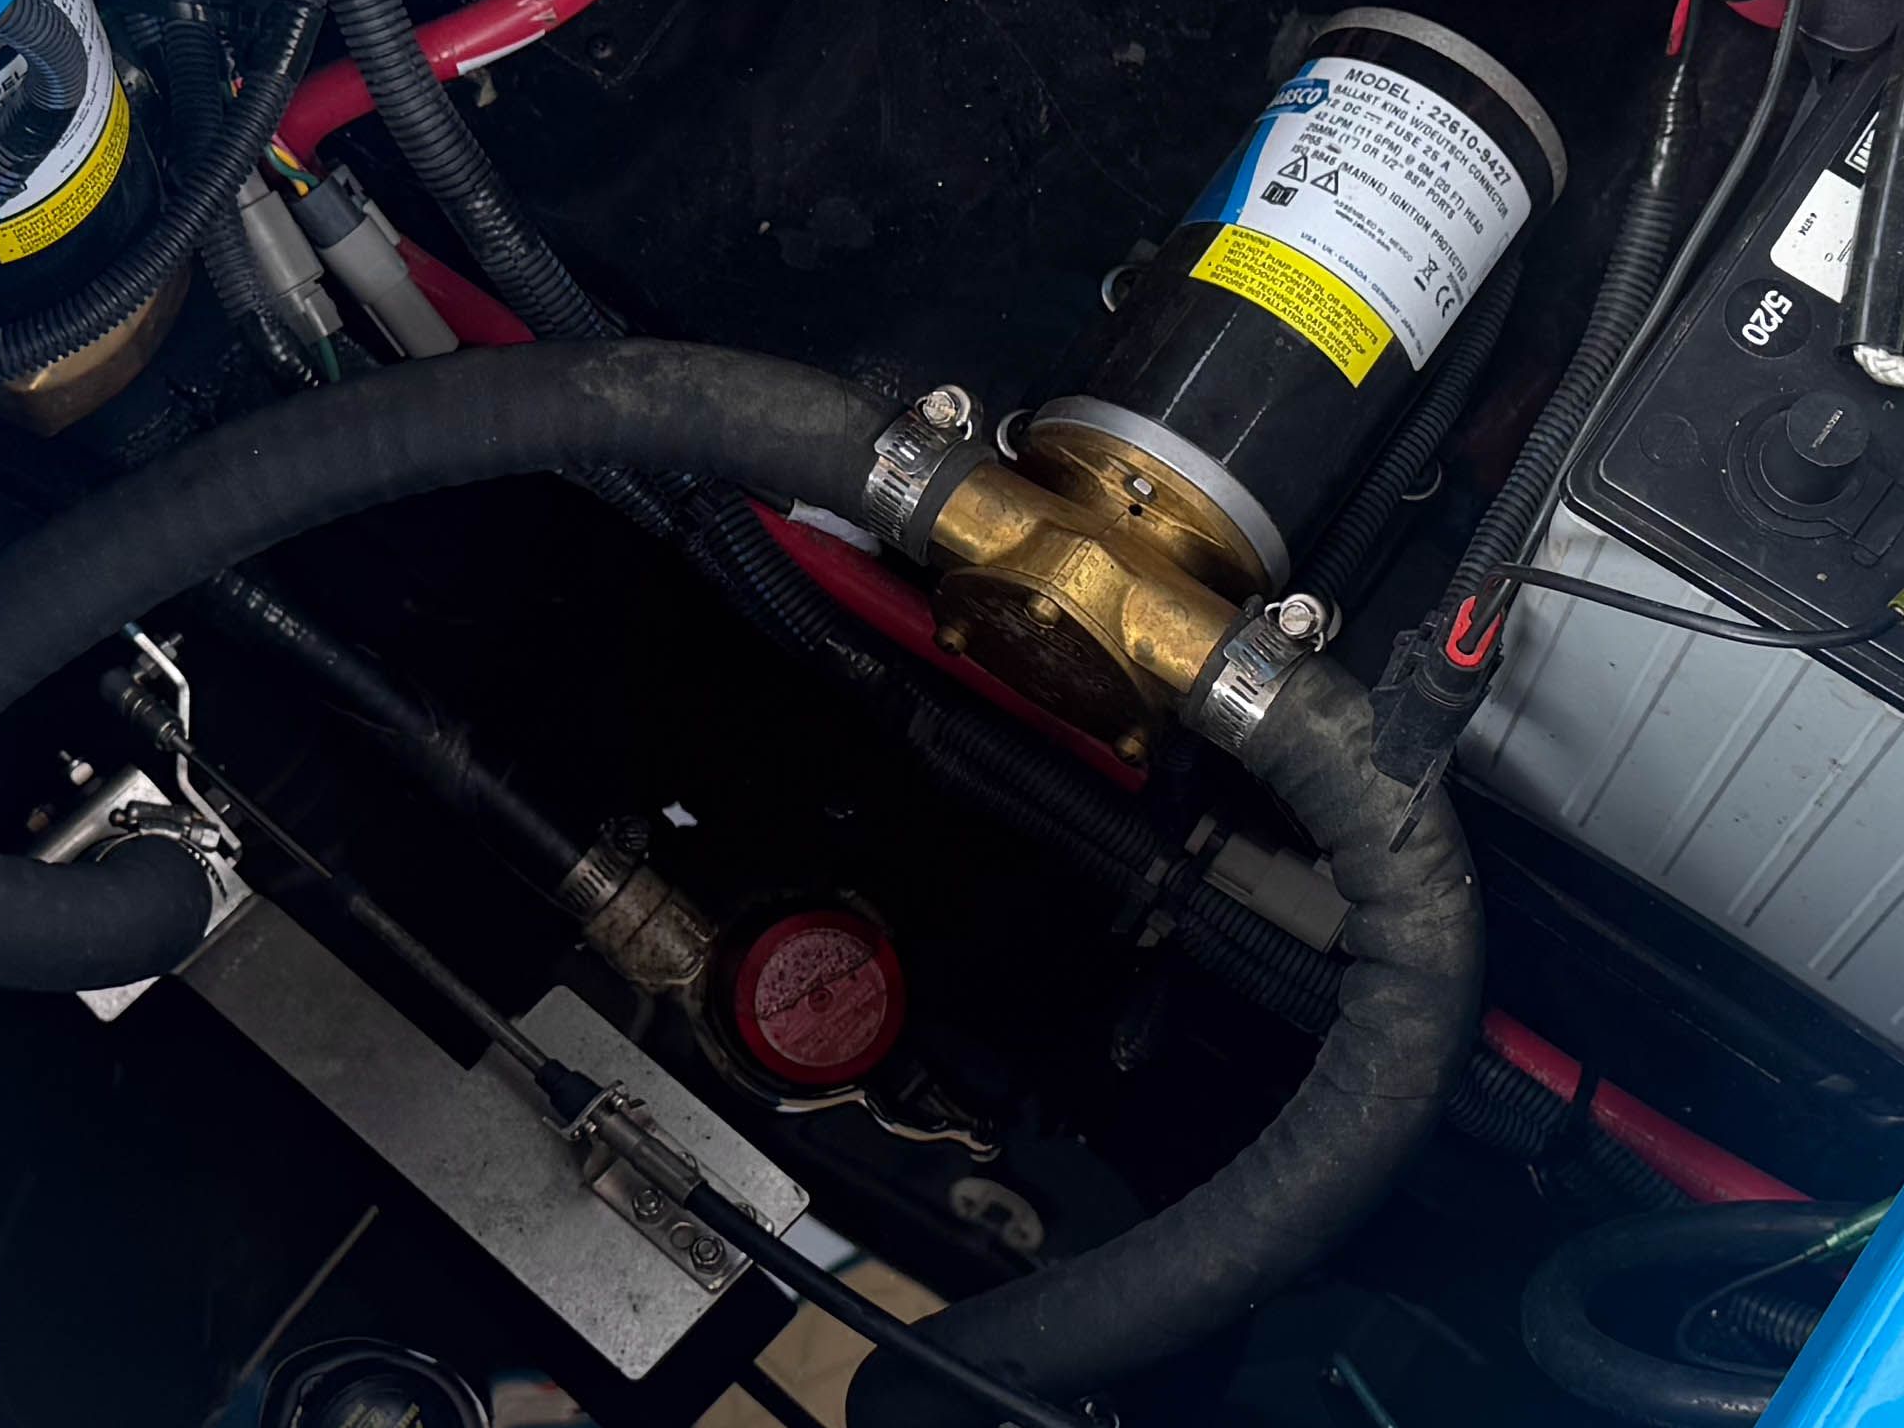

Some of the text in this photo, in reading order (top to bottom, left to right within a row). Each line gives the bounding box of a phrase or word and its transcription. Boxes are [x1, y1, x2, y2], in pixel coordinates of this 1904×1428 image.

[1342, 102, 1362, 115] DC
[1385, 120, 1422, 148] FUSE
[1440, 160, 1450, 172] A
[1344, 68, 1512, 187] MODEL 22610-9427
[1381, 101, 1408, 121] KING
[1410, 116, 1469, 167] W/DEUTSCH
[1469, 164, 1509, 220] CONNECTOR
[1362, 143, 1380, 159] OR
[1404, 170, 1426, 188] BSP
[1426, 187, 1456, 220] PORTS
[1373, 134, 1403, 157] GPM)
[1434, 176, 1451, 194] (20
[1450, 191, 1465, 211] FT)
[1464, 207, 1484, 235] HEAD
[1337, 162, 1388, 197] (MARINE)
[1389, 192, 1432, 233] IGNITION
[1431, 229, 1468, 283] PROTECTED
[1239, 260, 1286, 290] PRODUCT
[1263, 252, 1293, 273] PUMP
[1290, 266, 1328, 297] PETROL
[1338, 302, 1380, 346] PRODUCTS
[1310, 291, 1344, 322] BELOW
[1254, 279, 1307, 318] TECHNICAL
[1303, 312, 1328, 335] DATA
[1325, 330, 1353, 357] SHEET
[1739, 288, 1795, 350] 5/20
